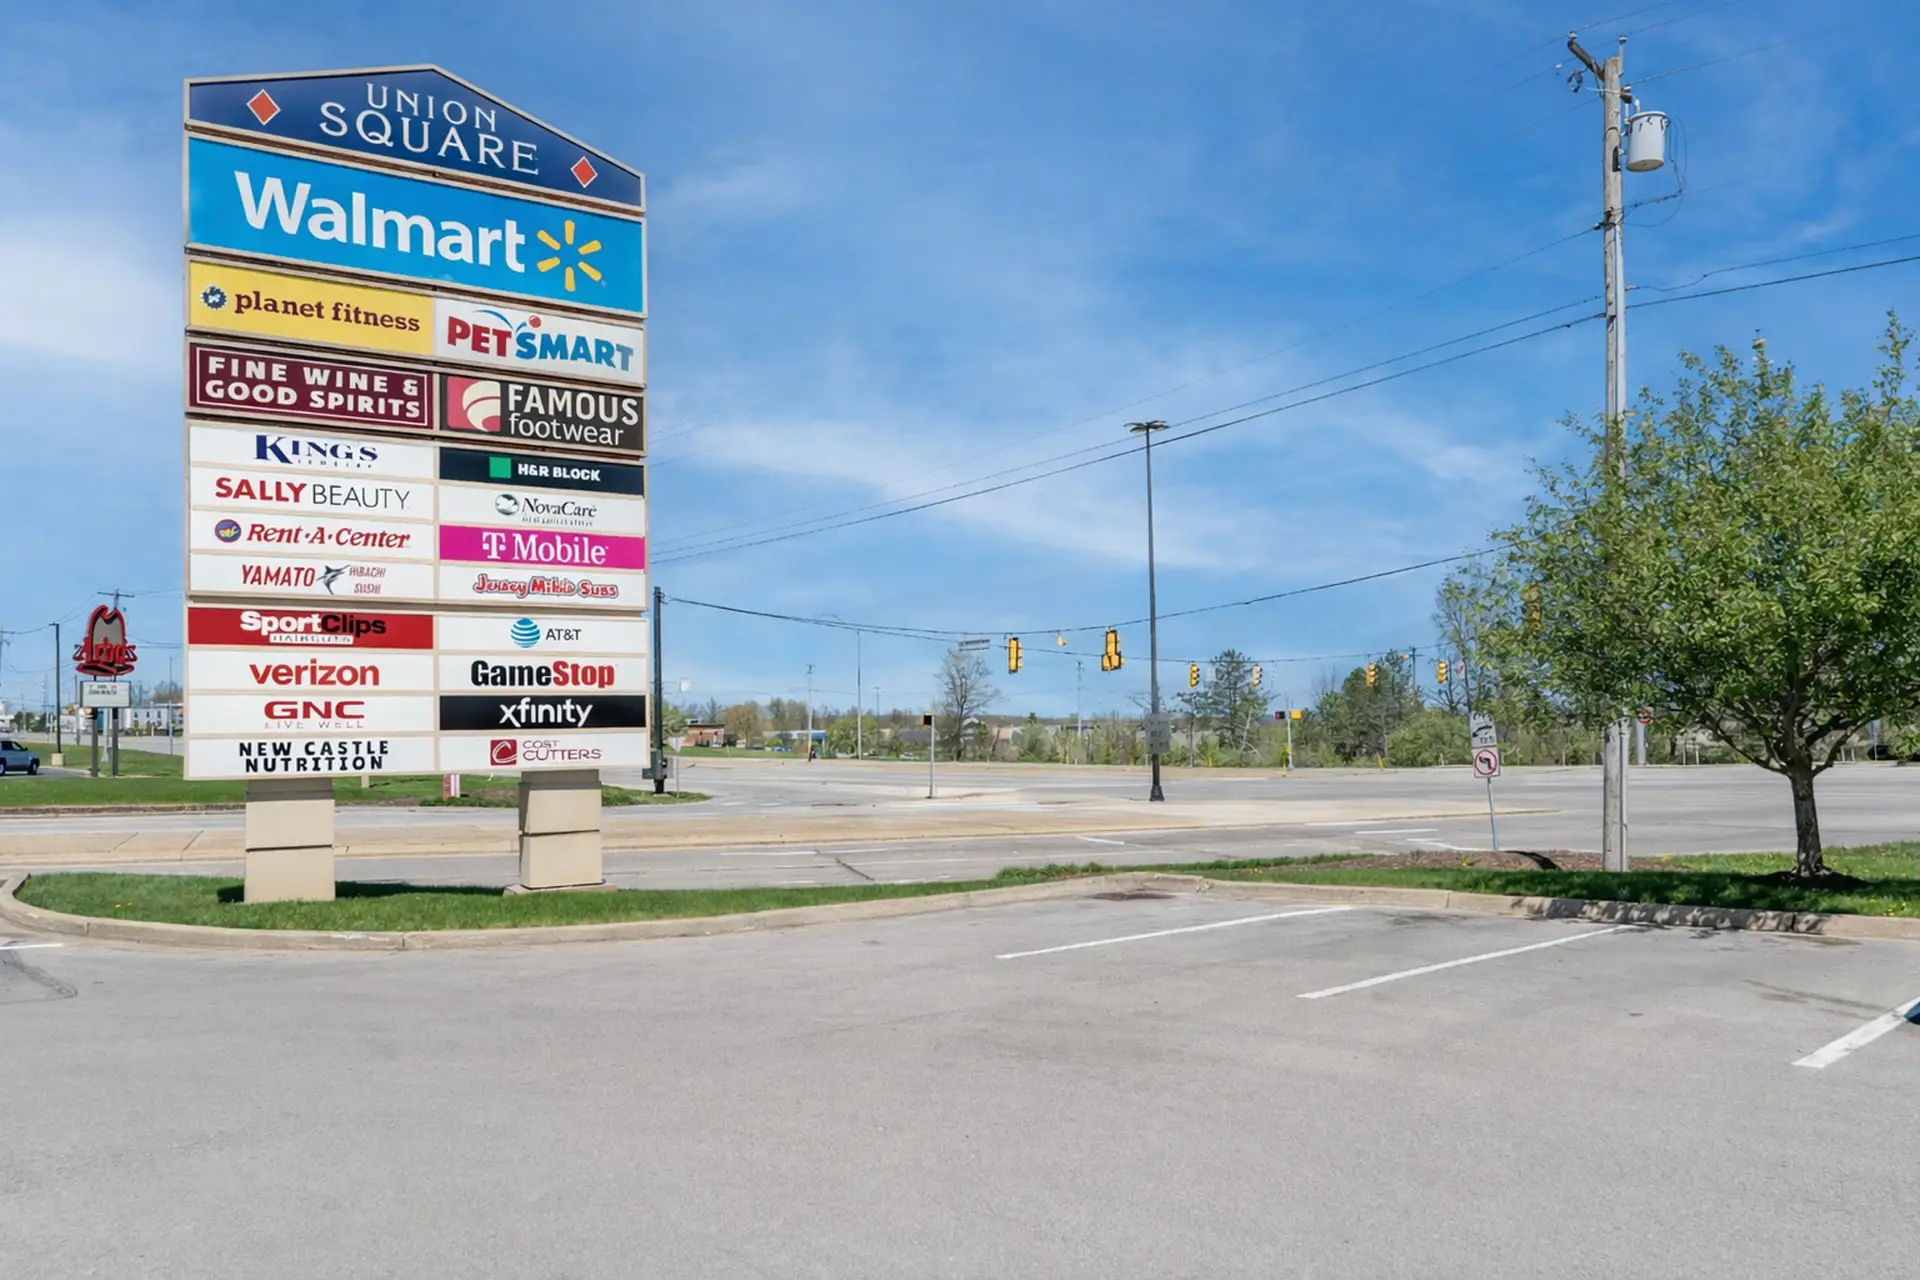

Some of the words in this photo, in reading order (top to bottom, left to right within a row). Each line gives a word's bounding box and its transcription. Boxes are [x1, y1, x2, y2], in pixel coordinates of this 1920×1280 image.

[367, 83, 496, 132] UNION
[320, 102, 539, 175] SQUARE
[234, 171, 526, 272] Walmart
[234, 291, 325, 319] planet
[332, 302, 420, 332] fitness
[208, 356, 287, 382] FINE
[303, 366, 388, 393] WINE
[403, 379, 419, 397] &
[205, 380, 298, 405] GOOD
[309, 391, 420, 418] SPIRITS
[508, 384, 639, 426] FAMOUS
[508, 413, 624, 446] footwear
[518, 463, 550, 478] H&R
[553, 467, 601, 482] BLOCK
[215, 477, 307, 504] SALLY
[312, 484, 410, 510] BEAUTY
[521, 497, 597, 517] NovaCare
[242, 564, 316, 588] YAMATO
[545, 628, 582, 641] AT&T
[249, 658, 380, 686] verizon
[471, 660, 615, 688] GameStop
[264, 701, 365, 719] GNC
[499, 697, 593, 728] xfinity
[264, 721, 304, 729] LIVE
[318, 721, 365, 729] WELL
[239, 742, 292, 756] NEW
[304, 740, 389, 756] CASTLE
[522, 740, 559, 748] COST
[522, 749, 602, 761] CUTTERS
[245, 756, 383, 773] NUTRITION
